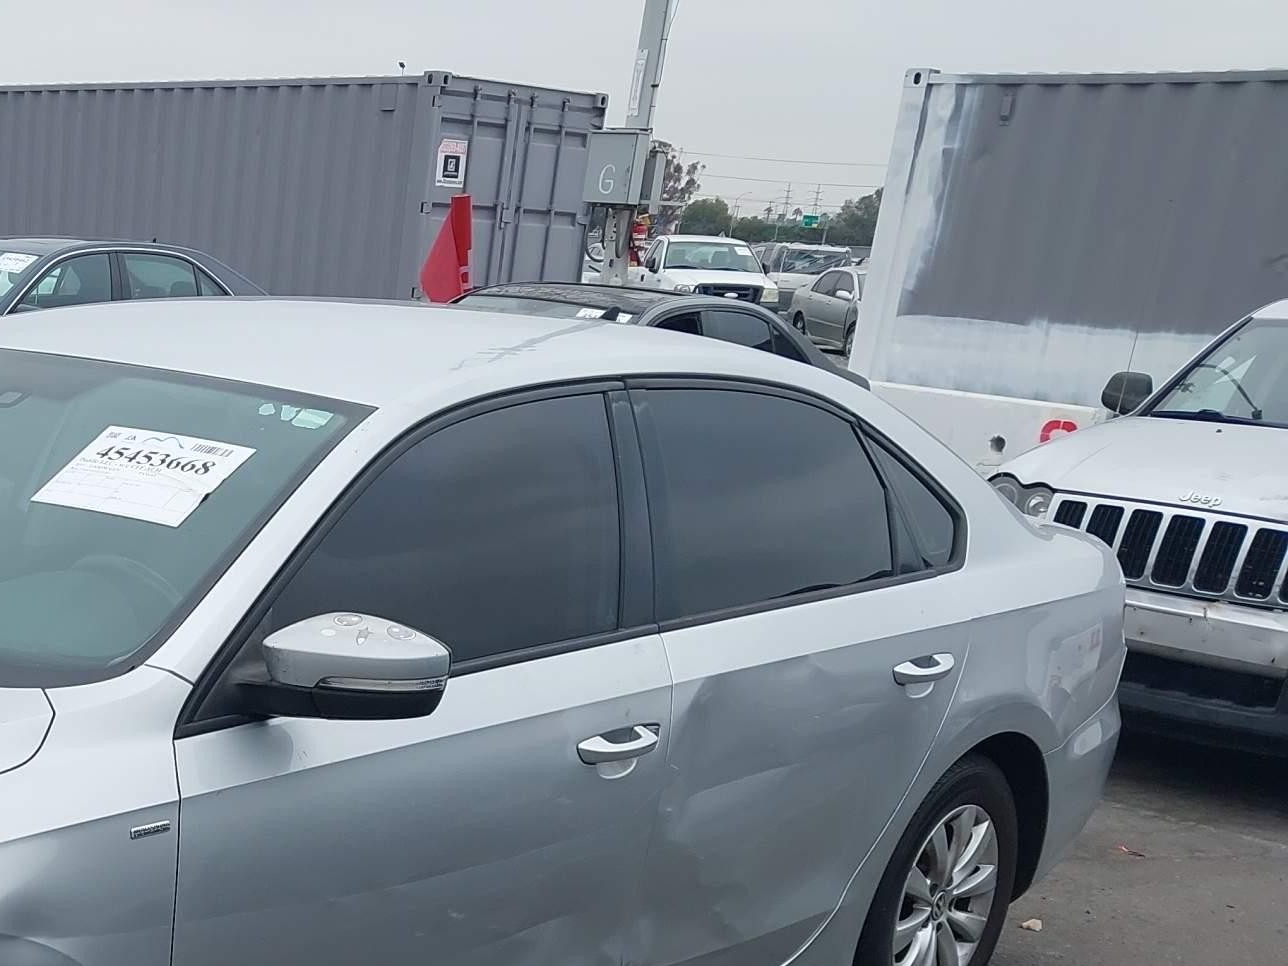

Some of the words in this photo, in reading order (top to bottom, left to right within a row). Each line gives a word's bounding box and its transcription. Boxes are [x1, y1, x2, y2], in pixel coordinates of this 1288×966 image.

[599, 163, 615, 194] G
[95, 445, 216, 476] 45453668
[1178, 490, 1222, 507] Jeep
